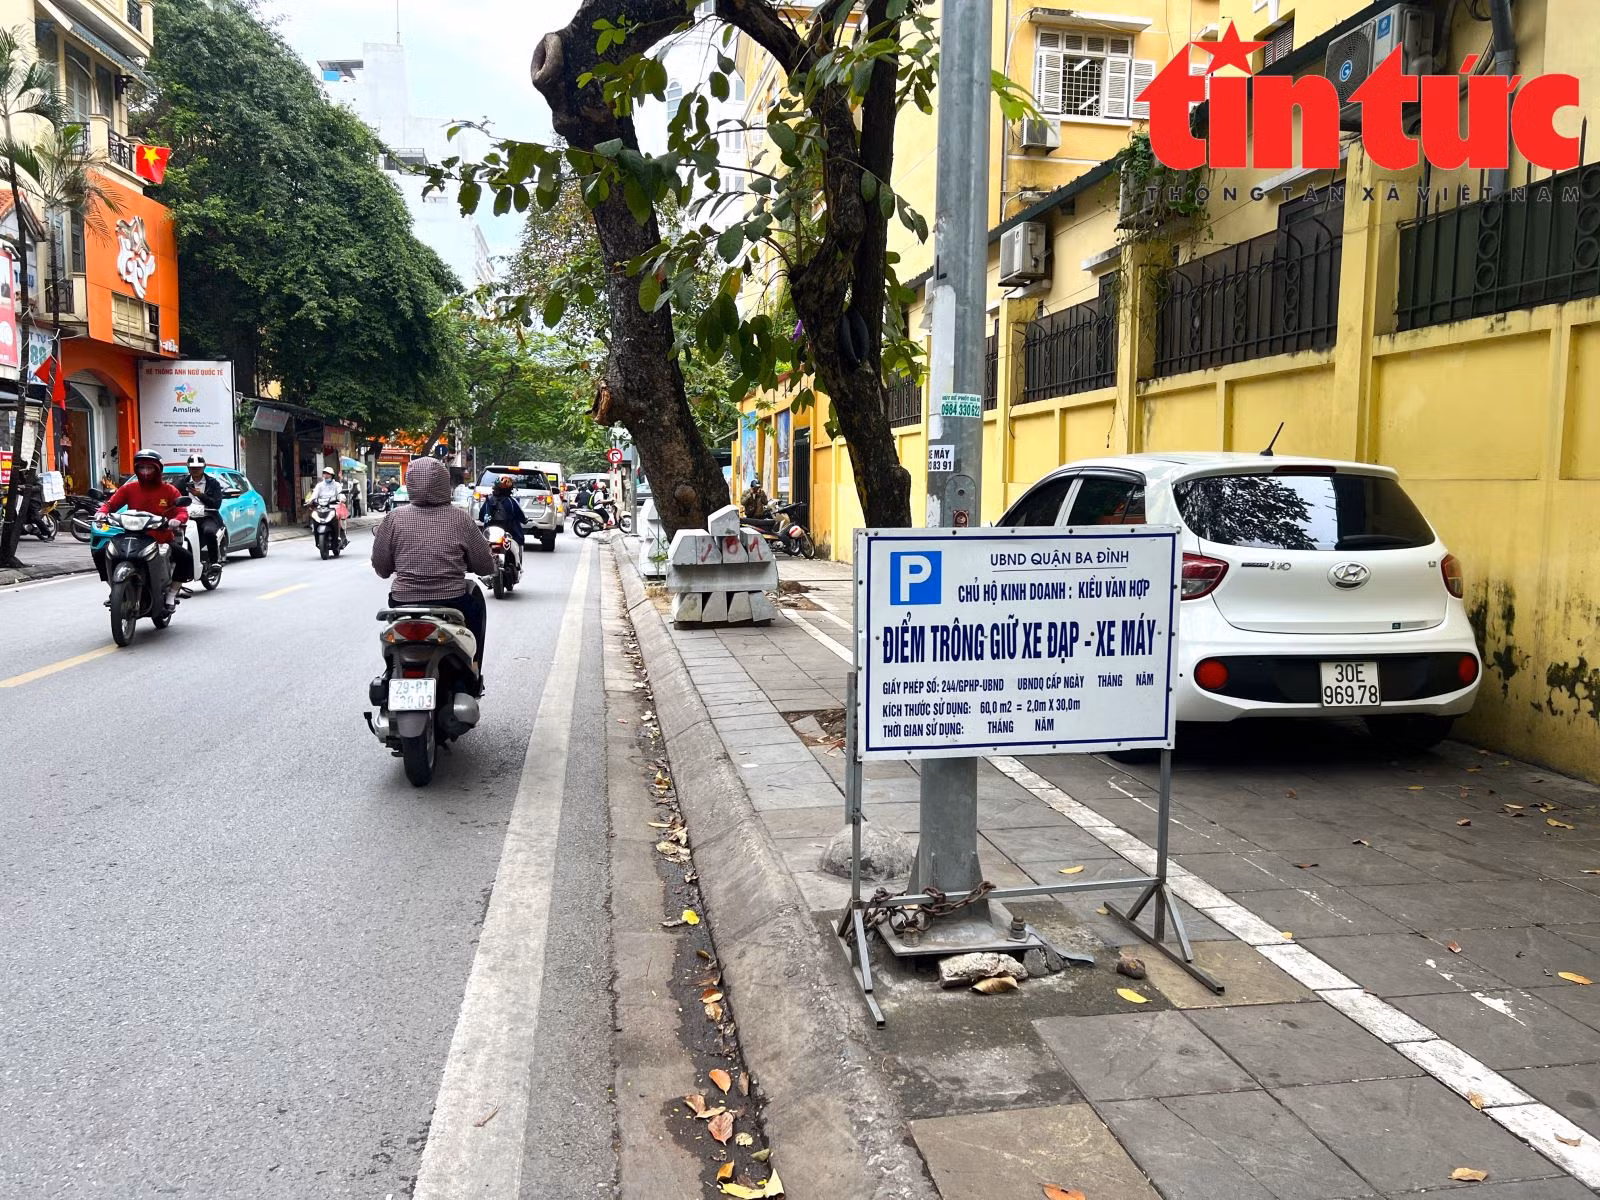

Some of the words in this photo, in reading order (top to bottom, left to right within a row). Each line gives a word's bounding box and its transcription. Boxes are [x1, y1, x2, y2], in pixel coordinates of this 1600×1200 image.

[934, 448, 950, 459] MÁY
[933, 461, 940, 470] 83
[943, 461, 951, 470] 91
[990, 552, 1026, 565] UBND
[1031, 550, 1071, 567] QUẬN
[1076, 552, 1092, 564] BA
[1096, 548, 1129, 563] ĐÌNH
[900, 555, 932, 601] P
[958, 577, 979, 602] CHỦ
[984, 580, 997, 605] HỘ
[1001, 585, 1026, 600] KINH
[1030, 582, 1065, 599] DOANH
[1106, 576, 1126, 598] VĂN
[1129, 578, 1150, 600] HỢP
[883, 611, 925, 663] ĐIỂM
[931, 617, 984, 662] TRÔNG
[990, 615, 1019, 660] GIỮ
[1022, 622, 1042, 658] XE
[1048, 622, 1079, 664] ĐẠP
[1096, 621, 1115, 656] XE
[1121, 613, 1156, 656] MÁY
[1335, 664, 1365, 682] 30E
[396, 681, 427, 694] 29-P1
[883, 678, 901, 694] GIẤY
[903, 679, 924, 694] PHÉP
[942, 679, 1004, 693] 244/GPHP-UBND
[1018, 678, 1043, 691] UBNDQ
[1046, 672, 1061, 689] CẤP
[1064, 673, 1084, 688] NGÀY
[1098, 672, 1122, 687] THÁNG
[1136, 672, 1154, 685] NĂM
[1324, 685, 1378, 704] 969.78
[883, 702, 902, 717] KÍCH
[905, 700, 930, 716] THƯỚC
[933, 698, 945, 715] SỬ
[947, 702, 971, 717] DỤNG:
[1000, 701, 1012, 713] m2
[1027, 699, 1046, 712] 2,0m
[1048, 699, 1054, 711] X
[1056, 698, 1080, 712] 30,0m
[883, 722, 901, 737] THỜI
[904, 724, 923, 736] GIAN
[926, 718, 937, 736] SỬ
[939, 723, 964, 738] DỤNG:
[988, 719, 1014, 733] THÁNG
[1035, 717, 1054, 731] NĂM
